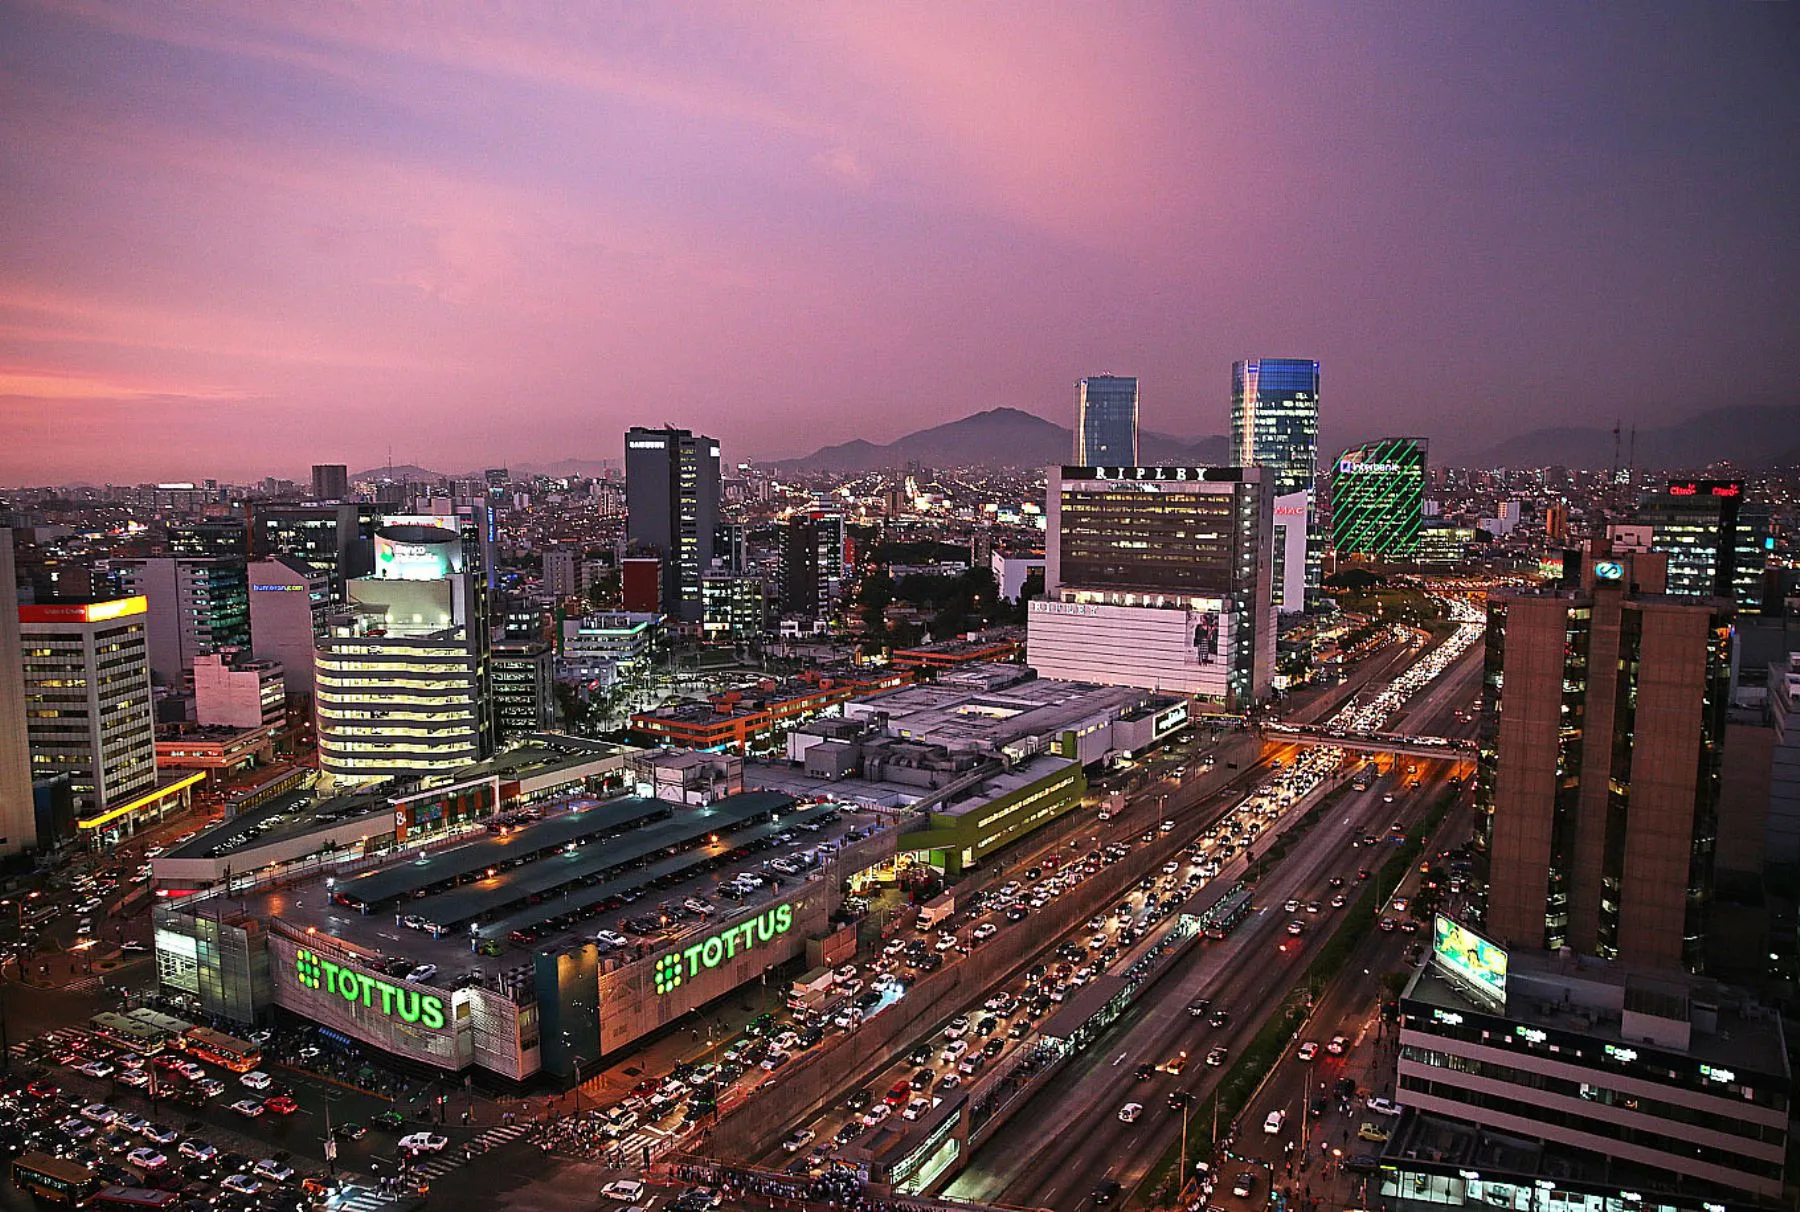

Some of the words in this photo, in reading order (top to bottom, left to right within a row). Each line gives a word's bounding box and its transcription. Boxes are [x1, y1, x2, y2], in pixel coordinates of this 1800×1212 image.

[1095, 466, 1208, 481] RIPLEY
[1669, 486, 1692, 496] Claro
[1033, 601, 1100, 617] RIPLEY
[684, 903, 793, 978] TOTTUS
[320, 959, 445, 1030] TOTTUS
